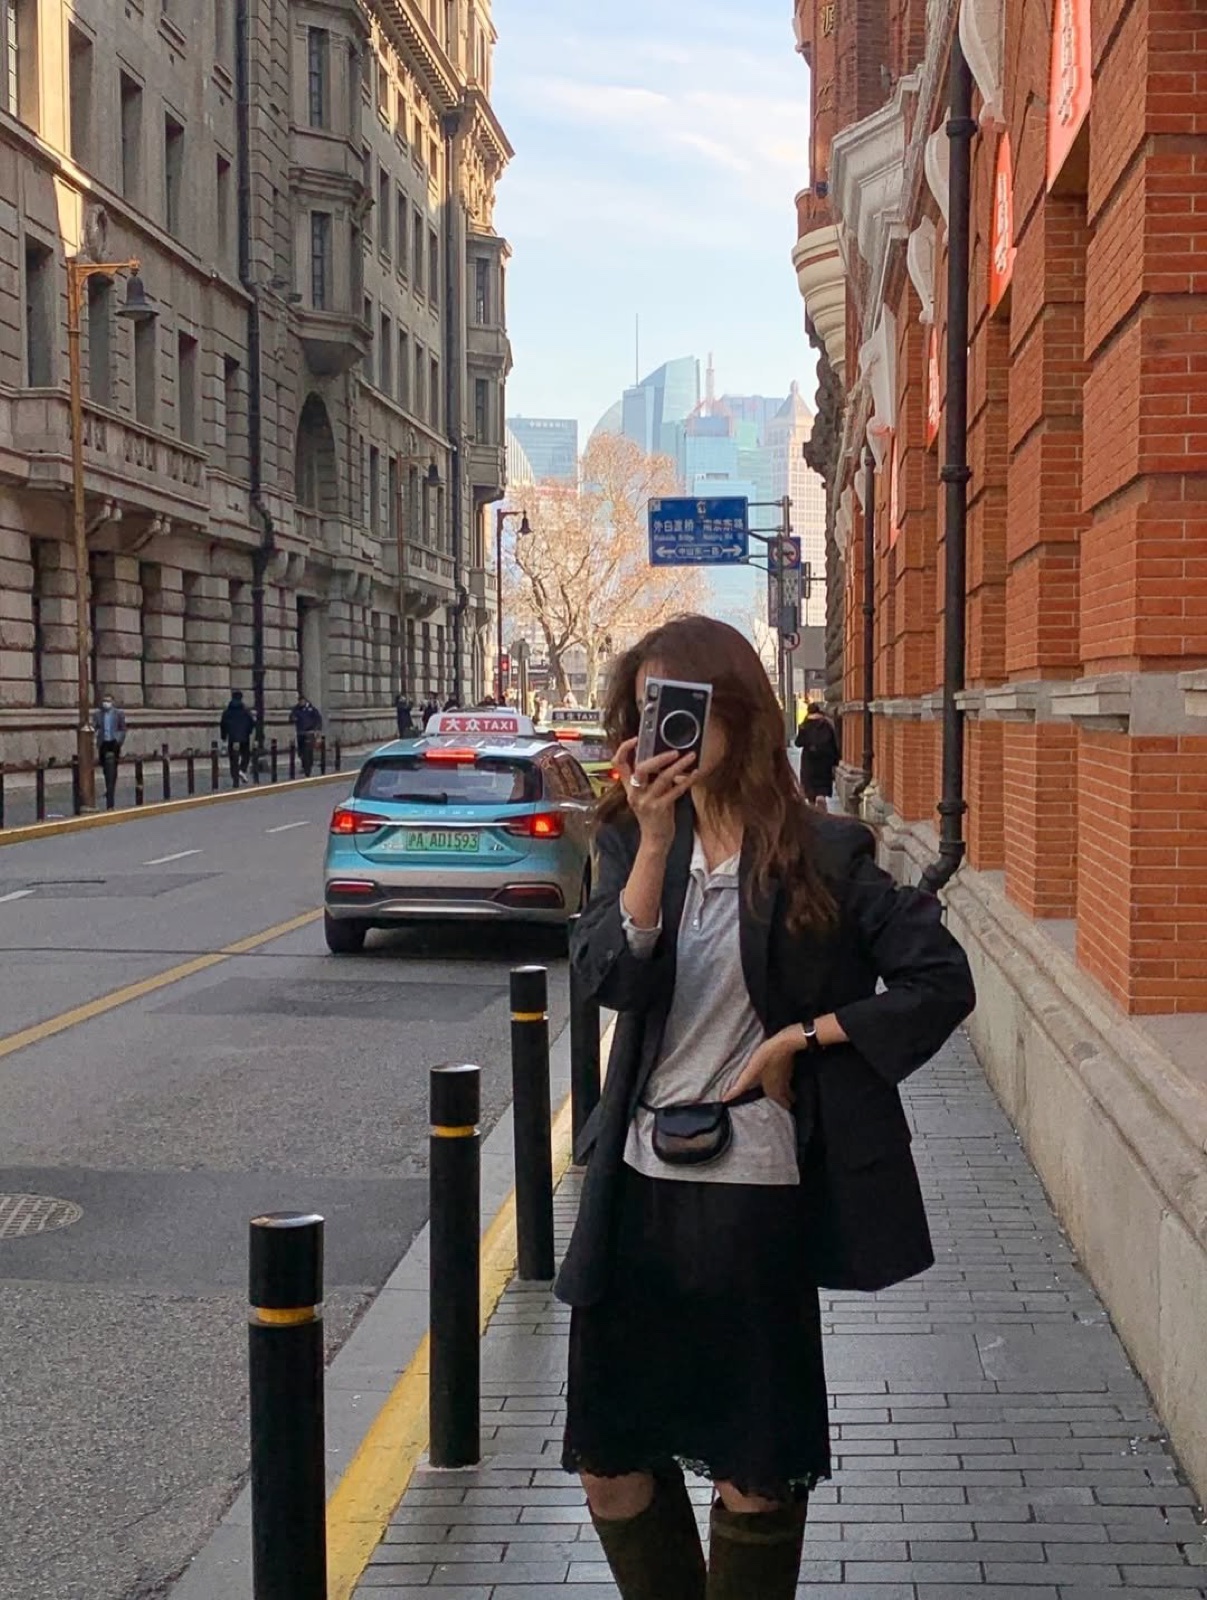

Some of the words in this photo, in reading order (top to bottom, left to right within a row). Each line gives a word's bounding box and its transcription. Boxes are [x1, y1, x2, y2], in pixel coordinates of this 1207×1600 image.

[445, 718, 481, 732] 大众
[484, 719, 514, 731] TAXI
[429, 832, 478, 849] AD1593
